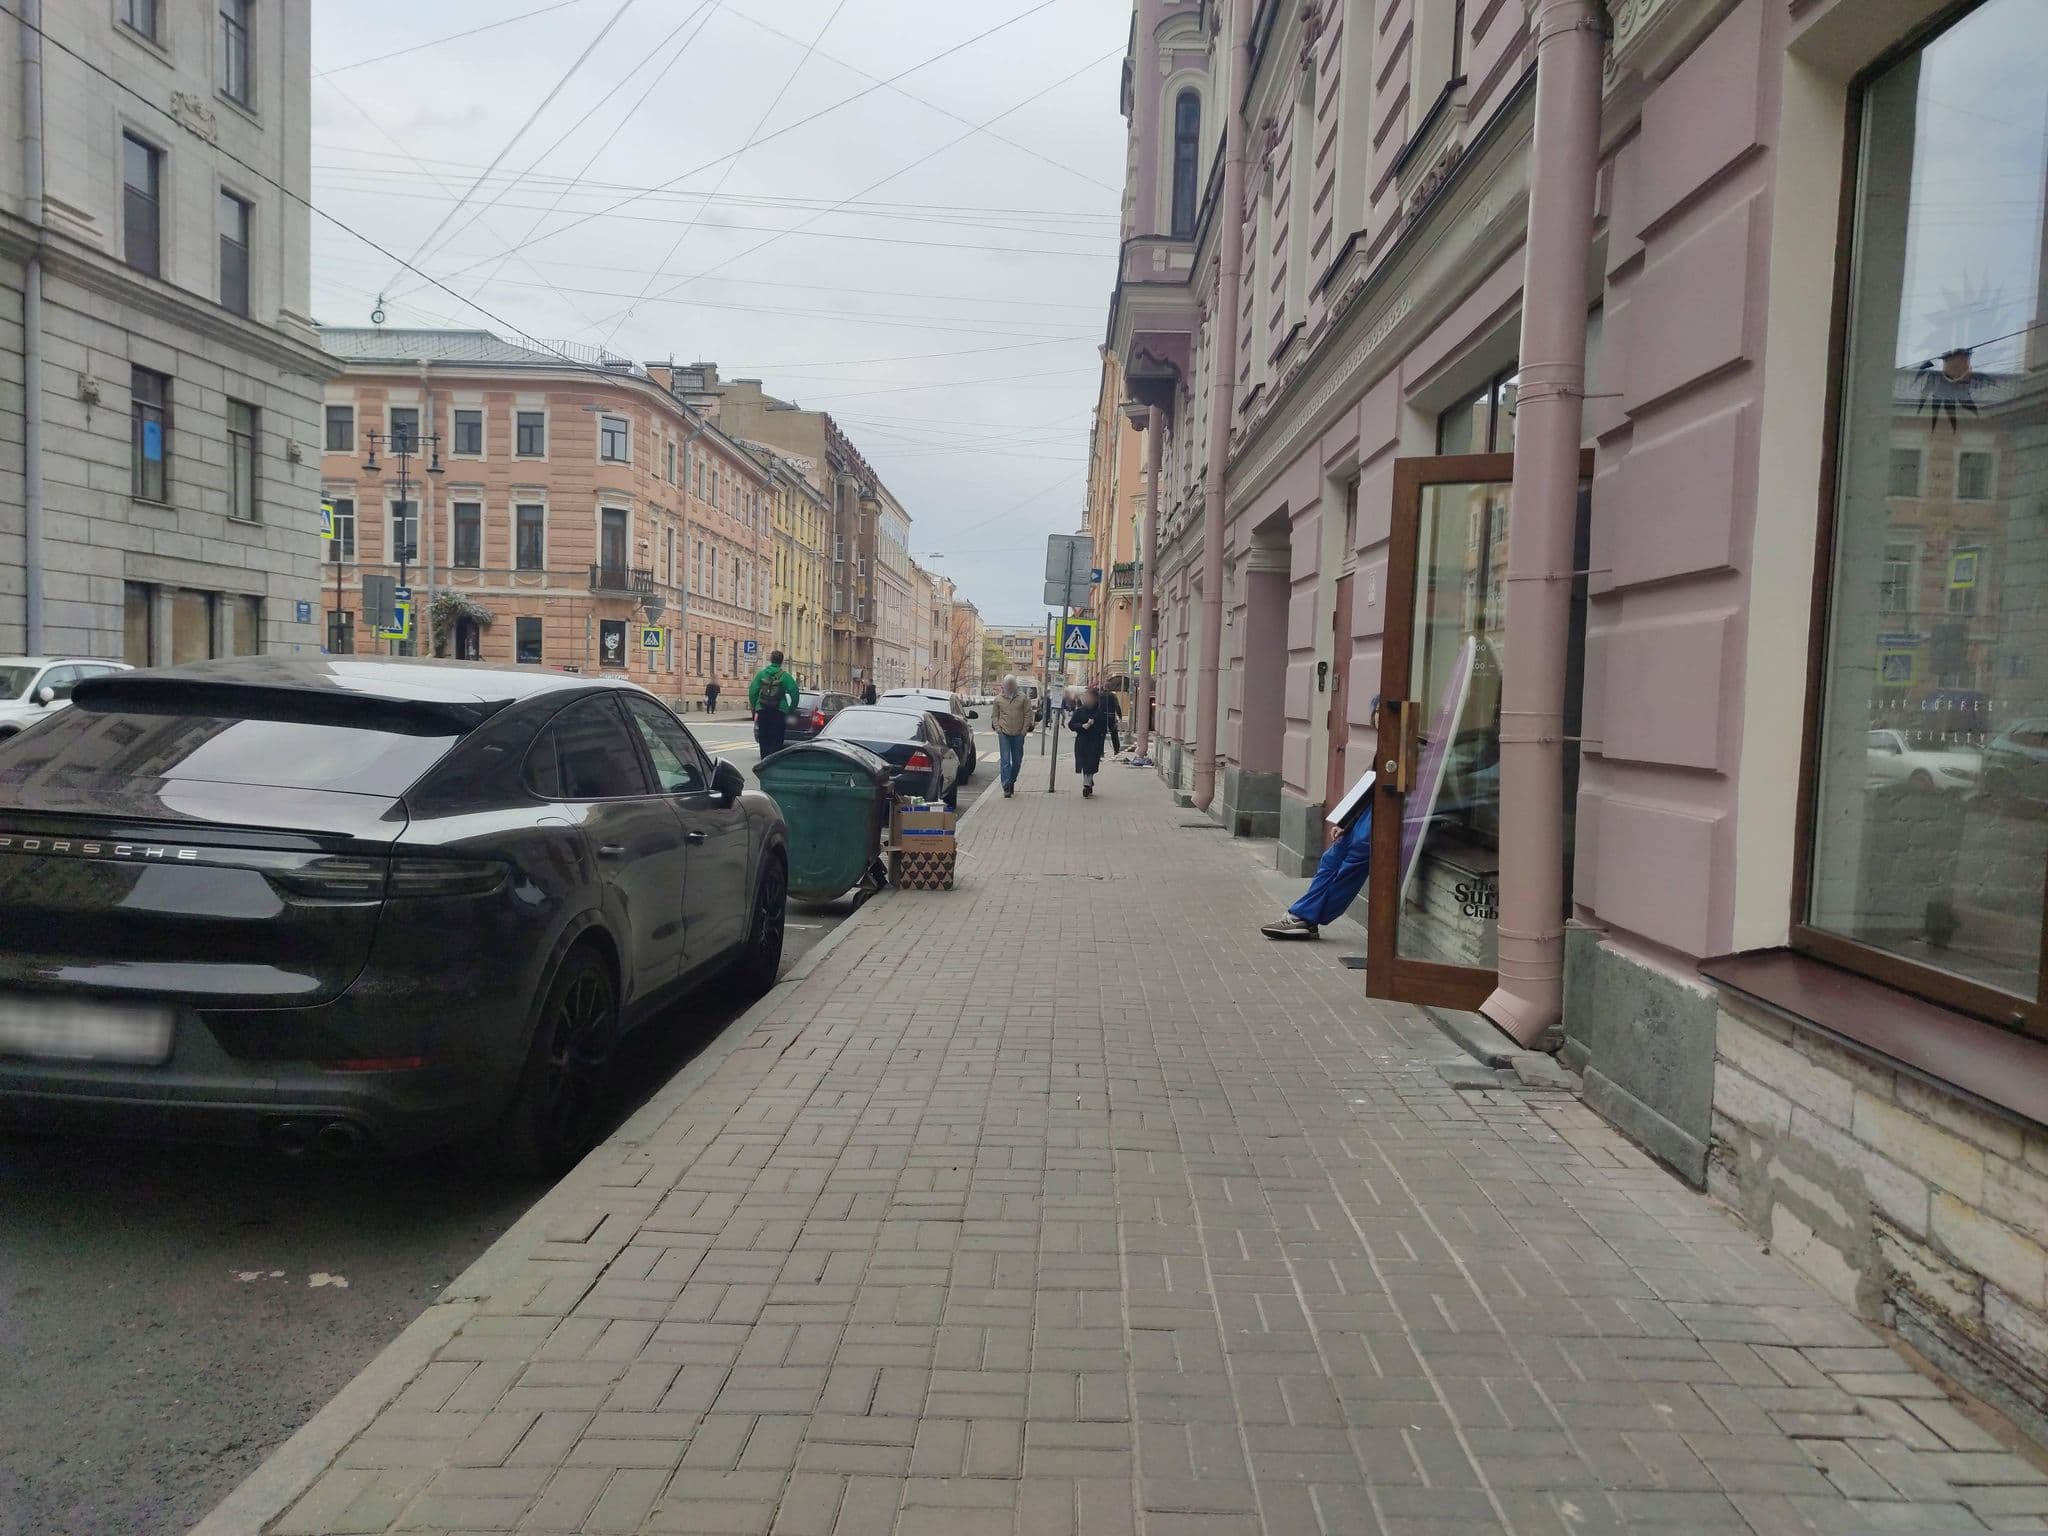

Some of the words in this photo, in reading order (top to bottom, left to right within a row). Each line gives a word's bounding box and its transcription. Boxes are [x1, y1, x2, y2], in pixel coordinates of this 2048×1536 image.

[1867, 699, 1908, 710] SURF
[1905, 730, 1986, 744] ECIALTY
[0, 838, 198, 859] PORSCHE
[1471, 878, 1496, 892] The
[1455, 883, 1499, 906] Sur
[1463, 903, 1499, 920] Club
